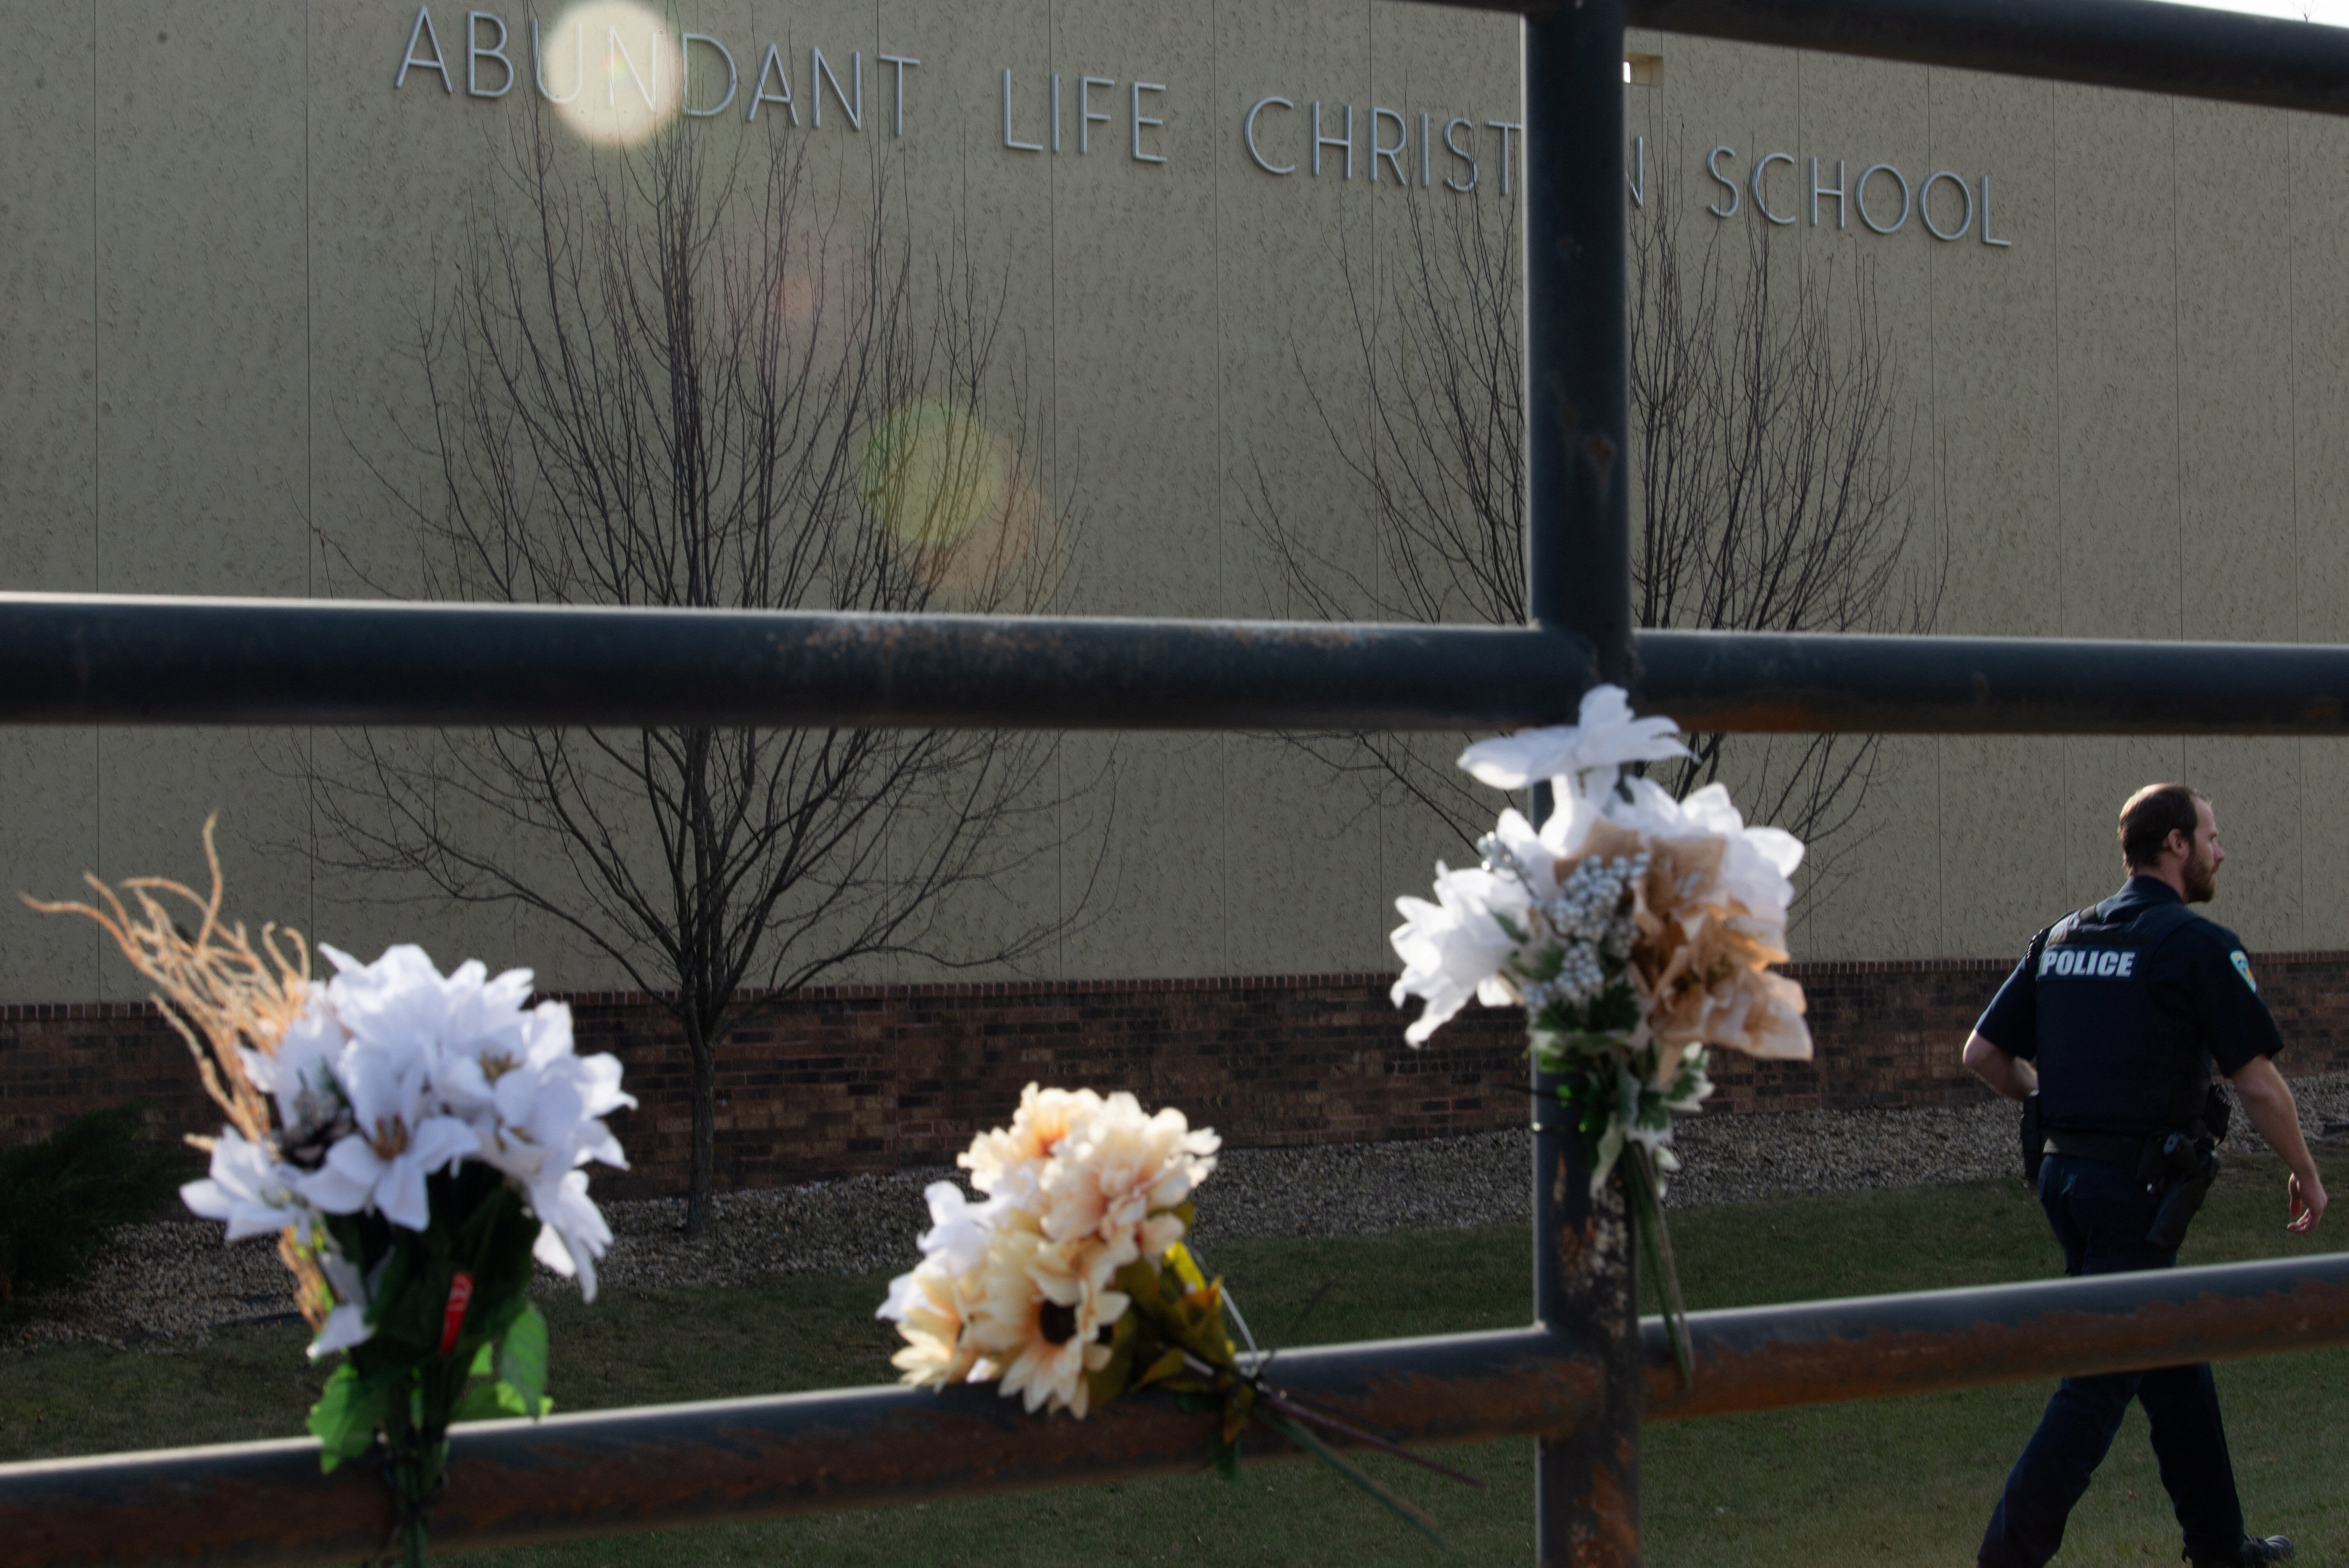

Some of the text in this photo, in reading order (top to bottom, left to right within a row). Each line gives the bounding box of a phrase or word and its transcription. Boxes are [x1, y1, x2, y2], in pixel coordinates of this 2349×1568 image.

[394, 5, 2012, 247] ABUNDANT LIFE CHRIST SCHOOL
[2040, 950, 2135, 977] POLICE
